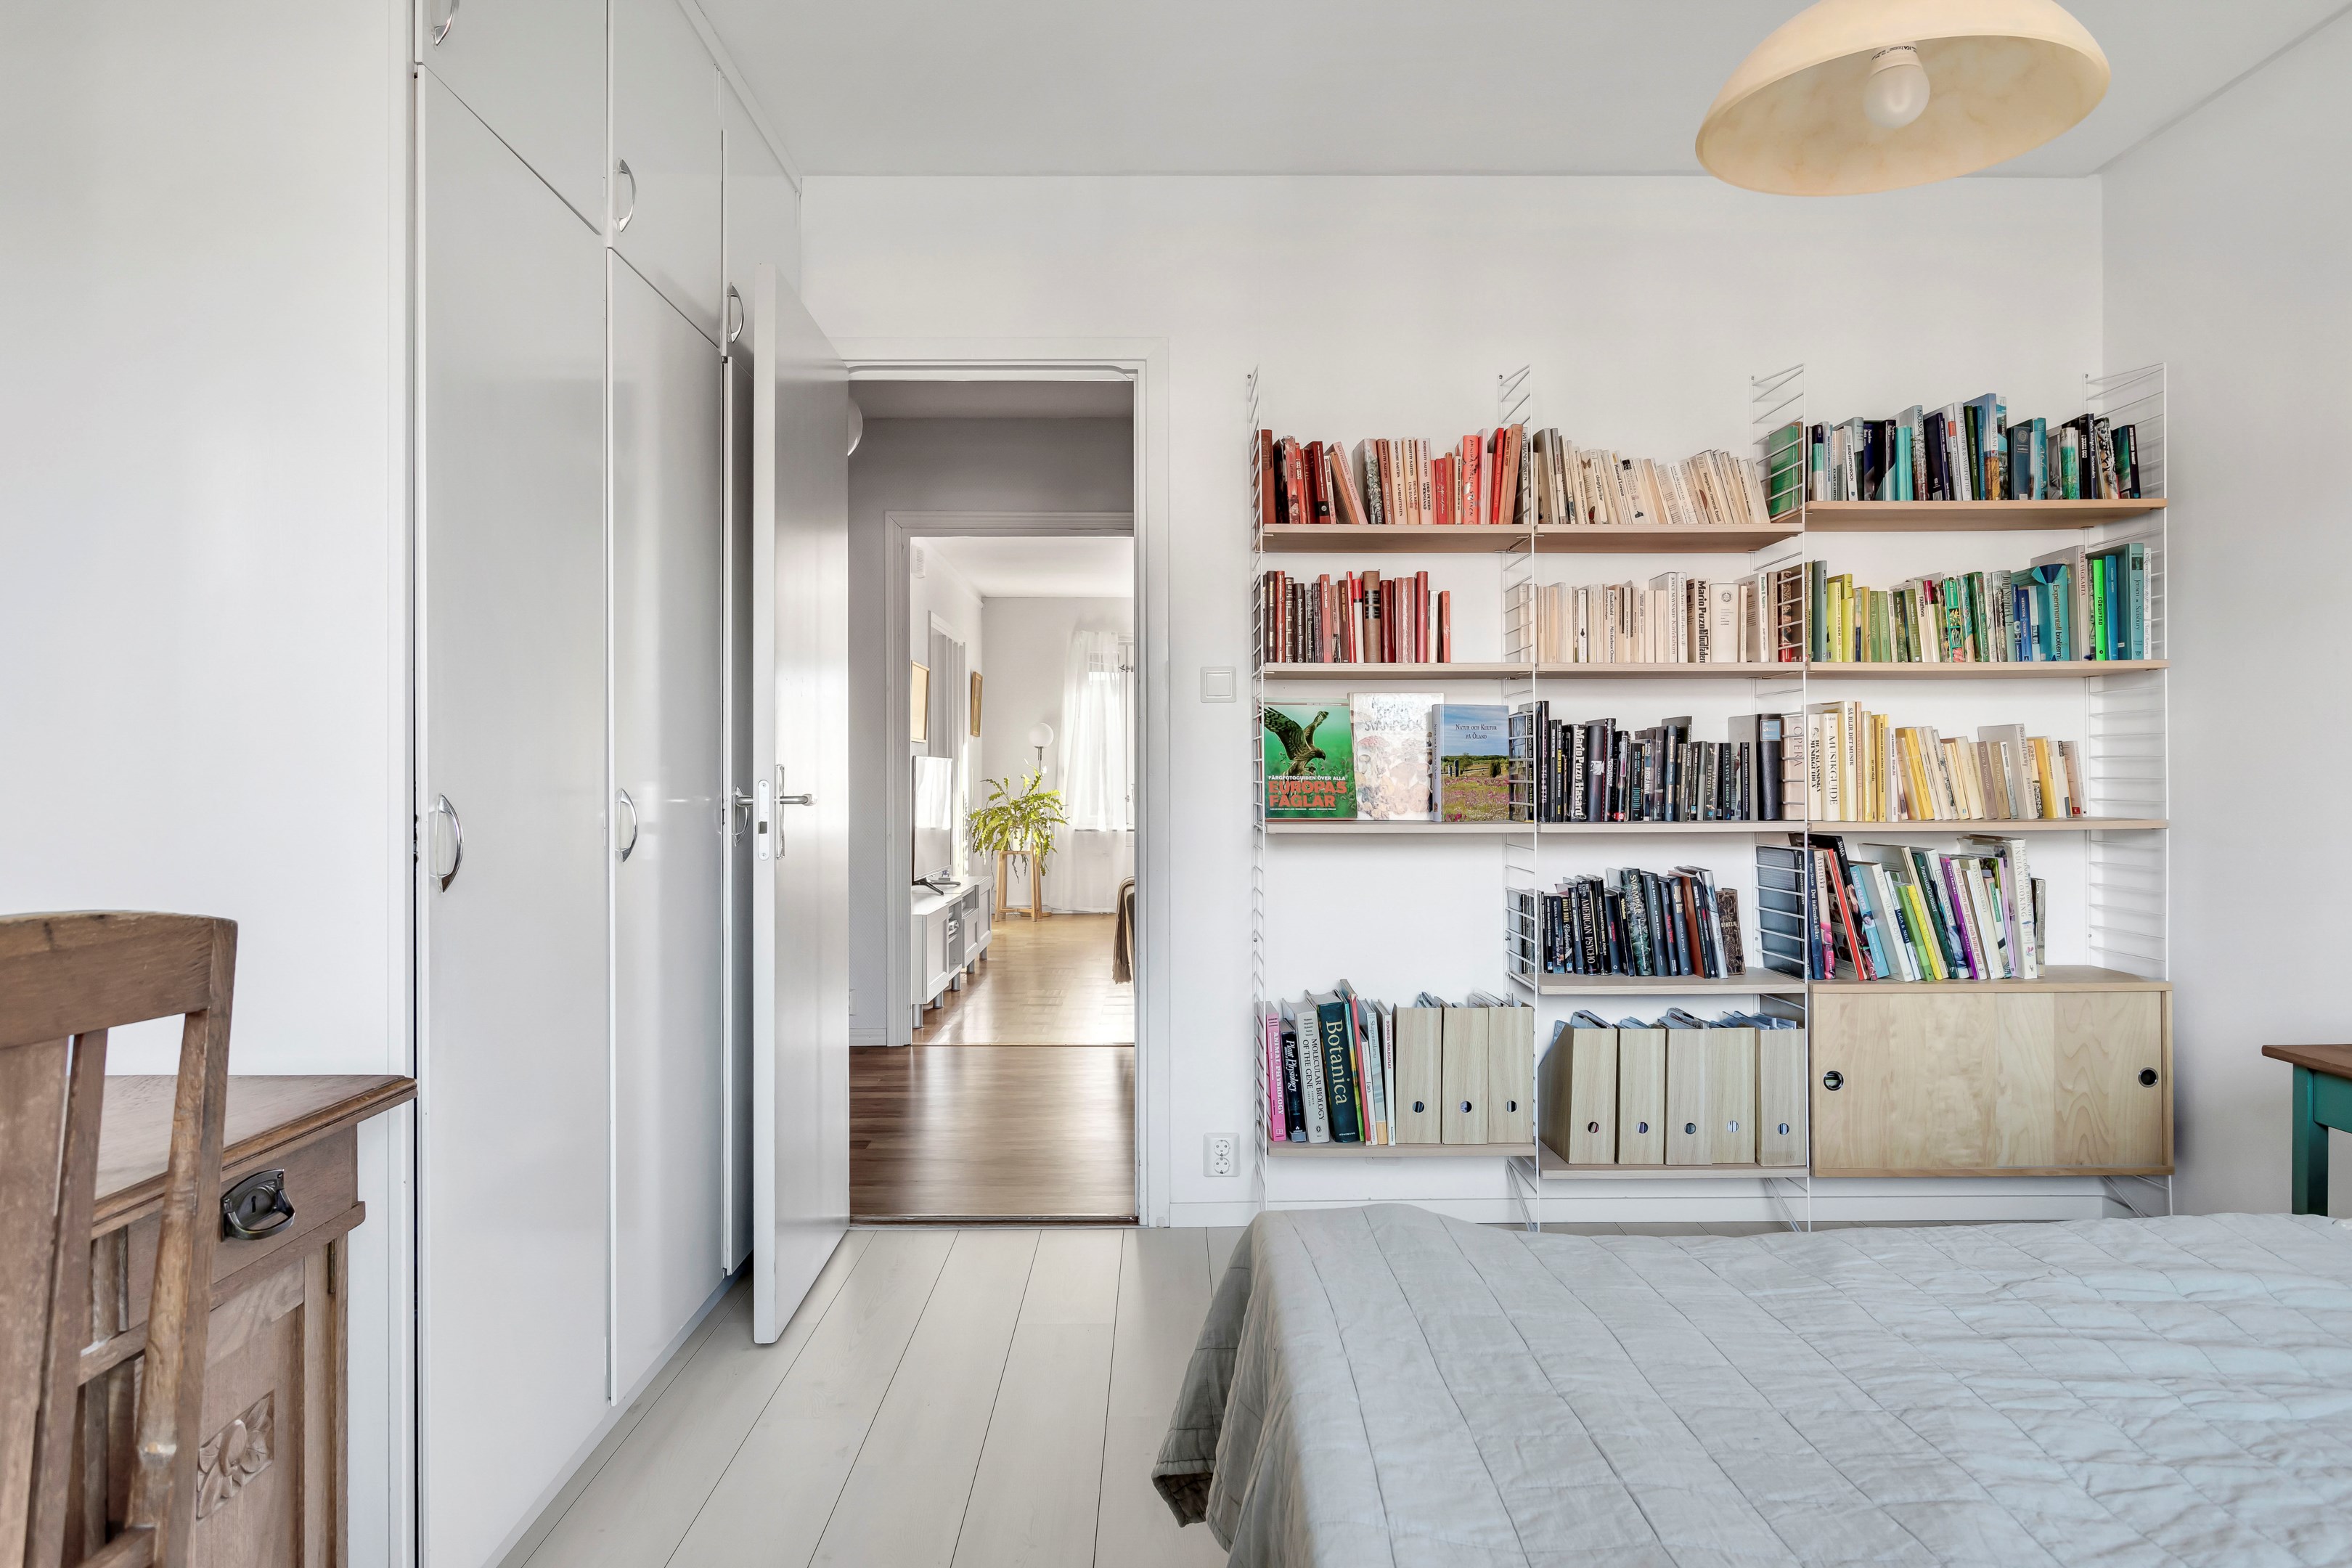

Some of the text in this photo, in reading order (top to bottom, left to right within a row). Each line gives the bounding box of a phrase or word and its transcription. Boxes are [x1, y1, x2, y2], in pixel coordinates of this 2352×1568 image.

[1703, 473, 1712, 494] Bergarter,
[1709, 494, 1718, 510] mineral,
[1699, 581, 1707, 605] Mario
[2051, 584, 2062, 630] Experimentell
[1848, 707, 1853, 716] SÅ
[1793, 726, 1803, 767] OPERA
[1267, 780, 1347, 794] EUROPAS
[1575, 727, 1585, 816] Mario Puzo Hasard
[1829, 735, 1838, 805] MUSIKGUIDE
[1269, 793, 1336, 807] FÅGLAR
[1817, 857, 1826, 889] Asiatiska
[1920, 865, 1938, 912] FREDAGSGOURMET
[1956, 867, 1964, 884] Stora
[1630, 874, 1641, 915] SVAMPAR
[1857, 889, 1867, 910] OLIVER
[1964, 904, 1969, 913] om
[2018, 879, 2027, 918] COOKING
[1581, 899, 1596, 963] AMERICAN PSYCHO
[1896, 910, 1905, 923] LAGA
[1964, 915, 1973, 925] god
[1970, 936, 1980, 952] billig
[1302, 1040, 1309, 1049] OF
[1285, 1040, 1298, 1092] Plant Physiology
[1326, 1019, 1350, 1105] Botanica
[1311, 1038, 1326, 1121] MOLECULAR BIOLOGY
